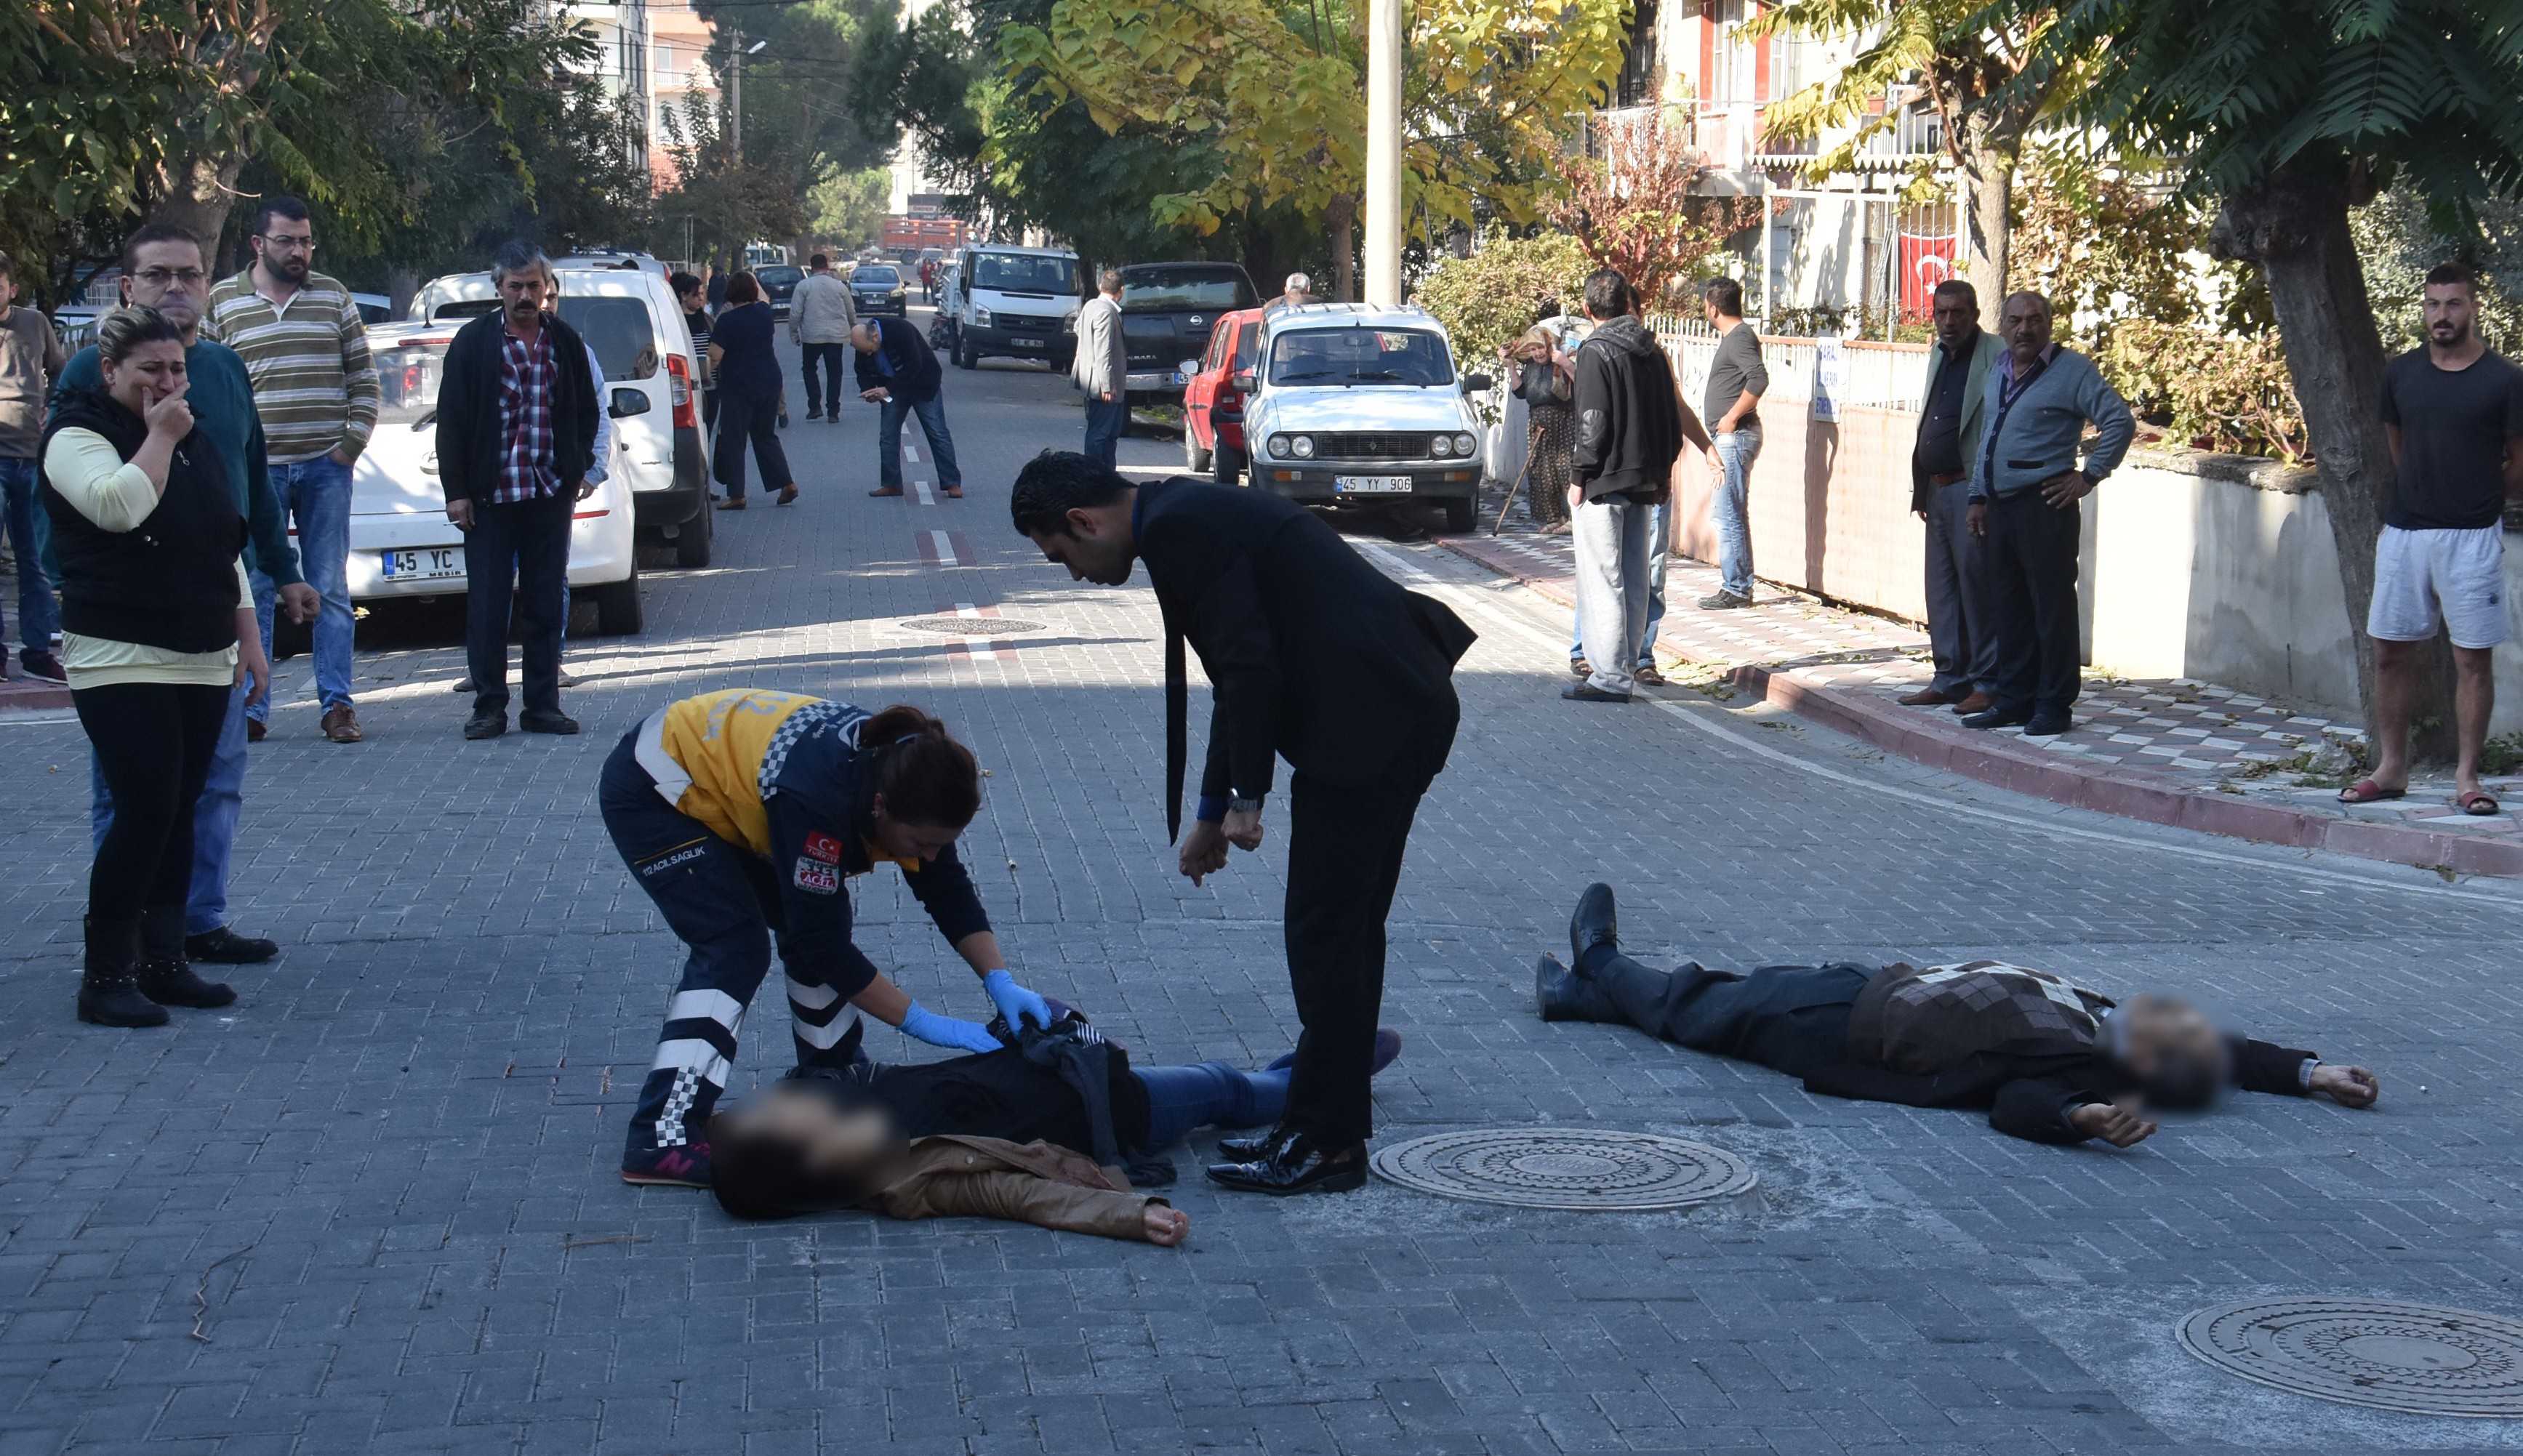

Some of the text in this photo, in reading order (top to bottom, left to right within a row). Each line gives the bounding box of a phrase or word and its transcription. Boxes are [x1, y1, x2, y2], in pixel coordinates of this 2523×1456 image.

[1343, 478, 1356, 491] 45
[1367, 478, 1380, 491] YY
[1390, 478, 1411, 491] 906
[395, 550, 453, 571] 45 YC
[643, 866, 654, 877] 112
